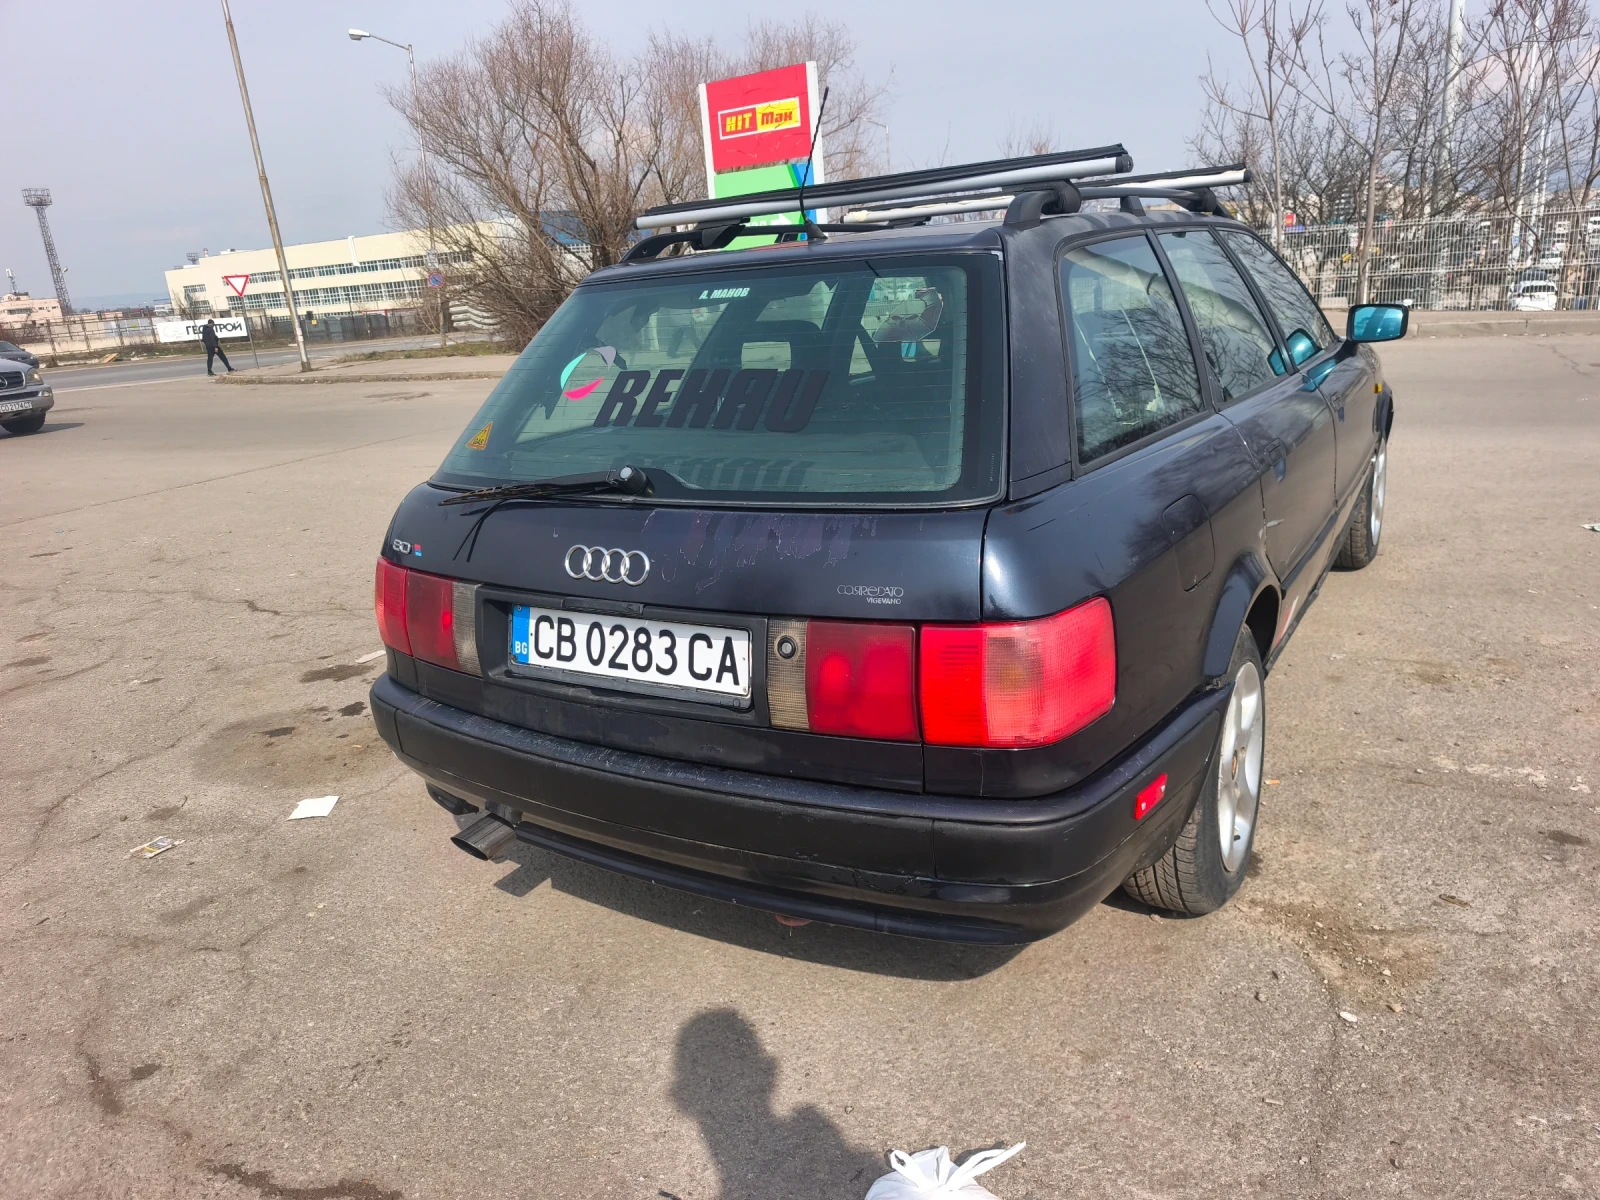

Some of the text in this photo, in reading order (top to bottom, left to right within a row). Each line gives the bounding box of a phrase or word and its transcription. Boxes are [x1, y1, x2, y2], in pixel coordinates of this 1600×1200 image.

[725, 112, 752, 132] HIT
[710, 287, 750, 299] МАНОВ
[185, 321, 243, 335] ГЕОТРОЙ
[592, 368, 831, 433] REHAU
[392, 538, 411, 555] 80
[866, 597, 902, 605] VIGEVANO
[514, 640, 528, 655] BG
[534, 614, 740, 686] CB 0283 CA
